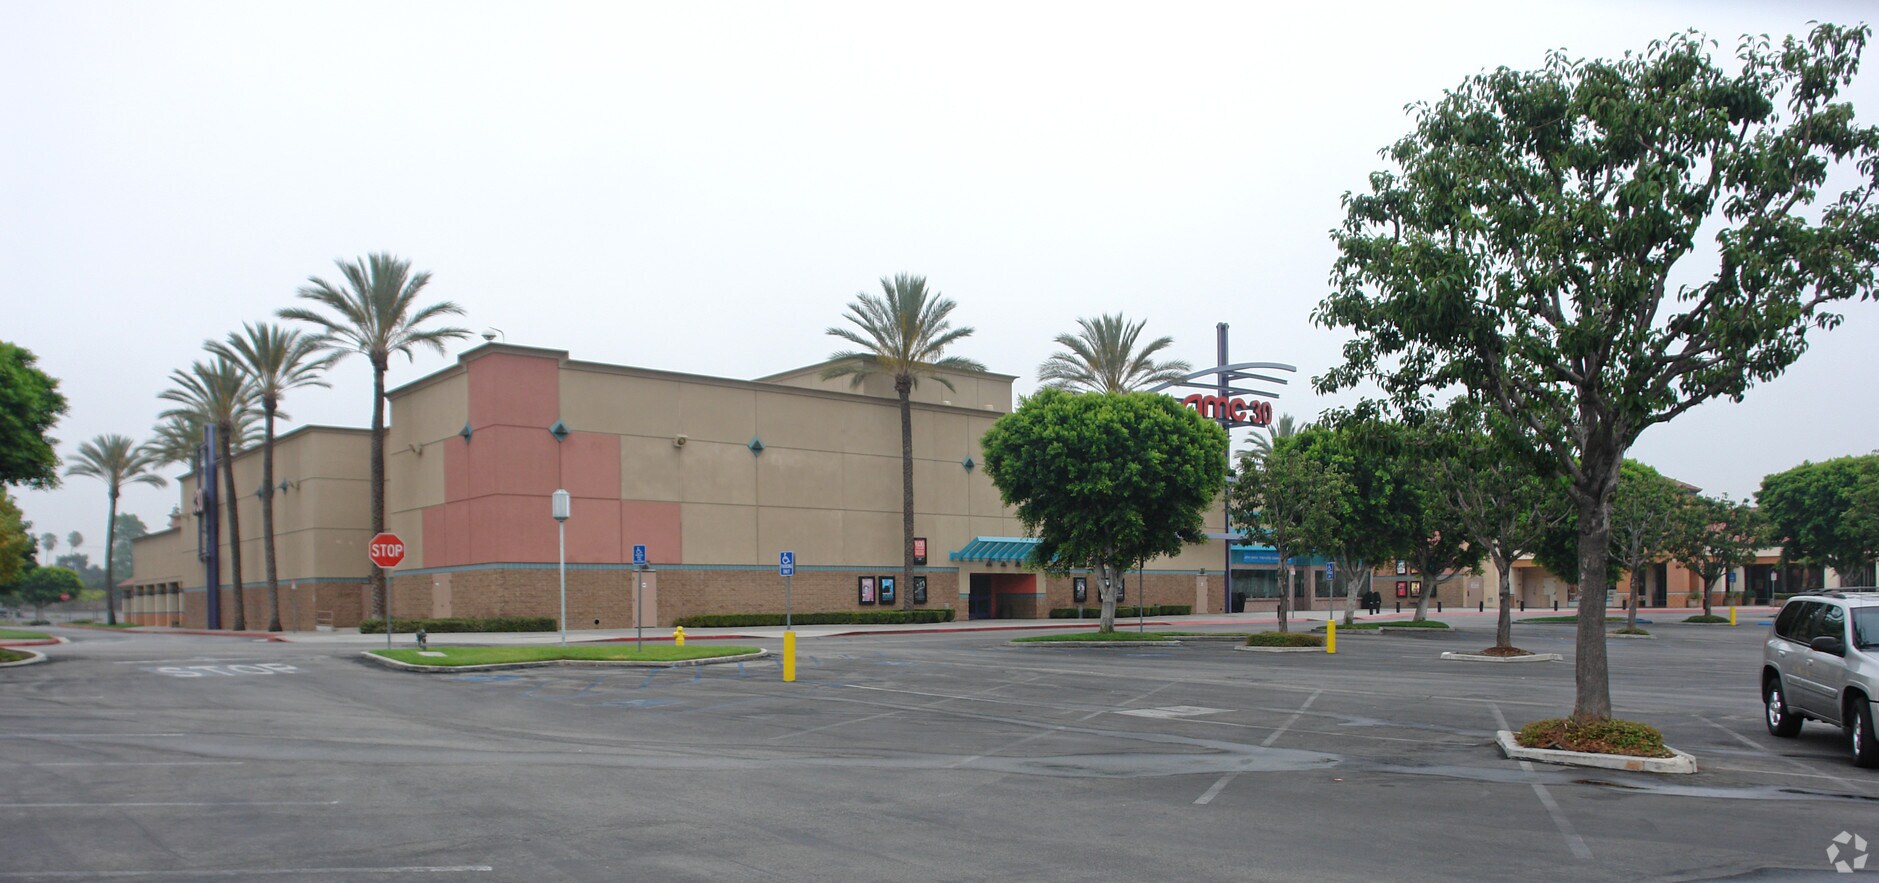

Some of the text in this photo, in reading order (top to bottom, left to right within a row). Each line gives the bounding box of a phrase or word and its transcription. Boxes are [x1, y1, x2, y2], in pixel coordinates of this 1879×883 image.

[1251, 399, 1273, 425] 30
[371, 543, 403, 558] STOP
[156, 662, 299, 678] STOP
